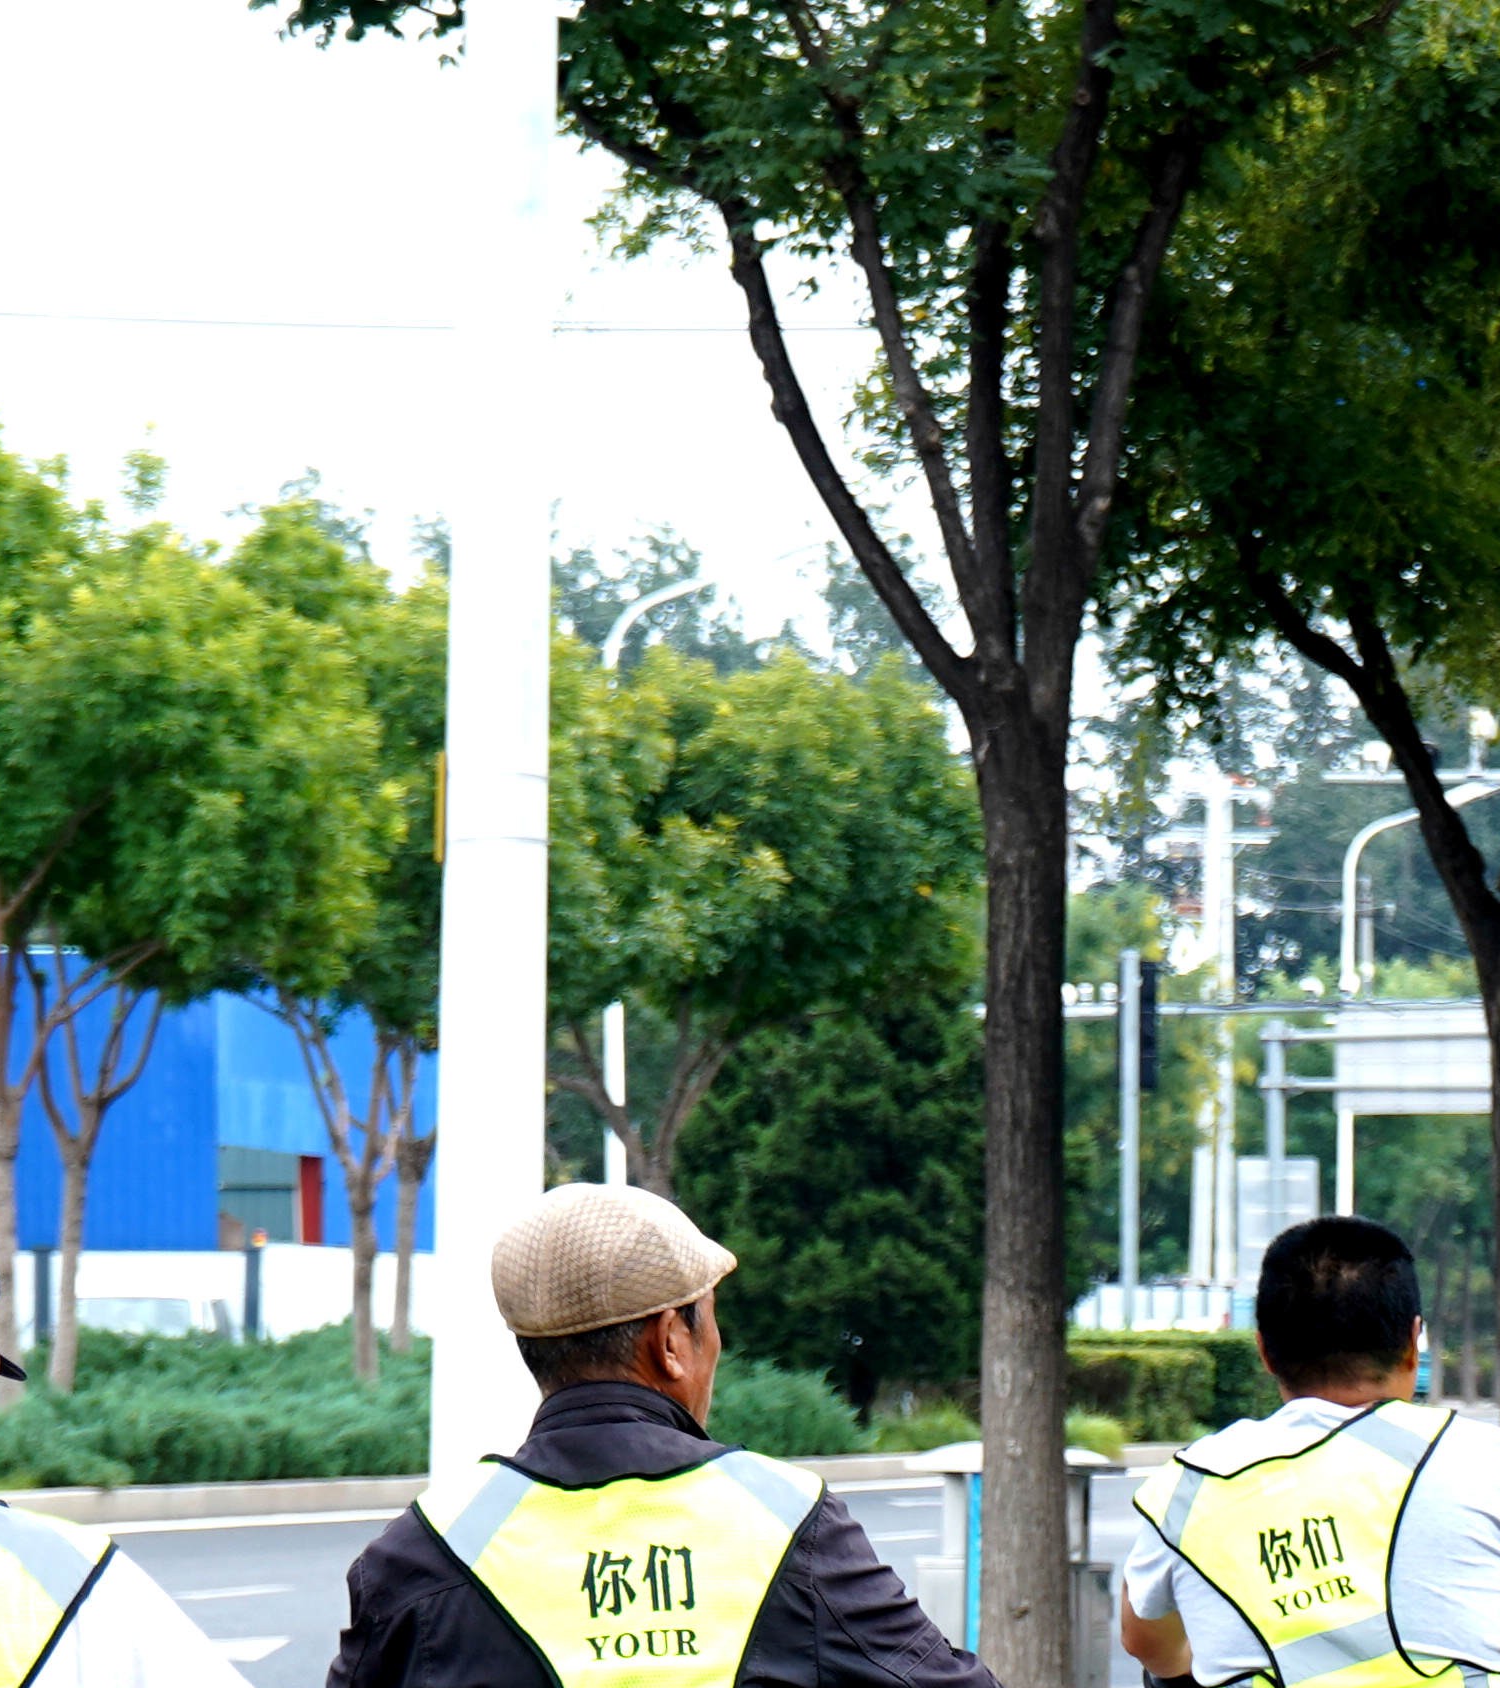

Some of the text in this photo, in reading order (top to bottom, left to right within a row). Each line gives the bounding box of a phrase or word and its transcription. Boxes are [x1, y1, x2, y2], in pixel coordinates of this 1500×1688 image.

[1259, 1515, 1344, 1584] 你们
[581, 1544, 696, 1619] 你们
[1272, 1576, 1356, 1617] YOUR
[586, 1629, 699, 1661] YOUR
